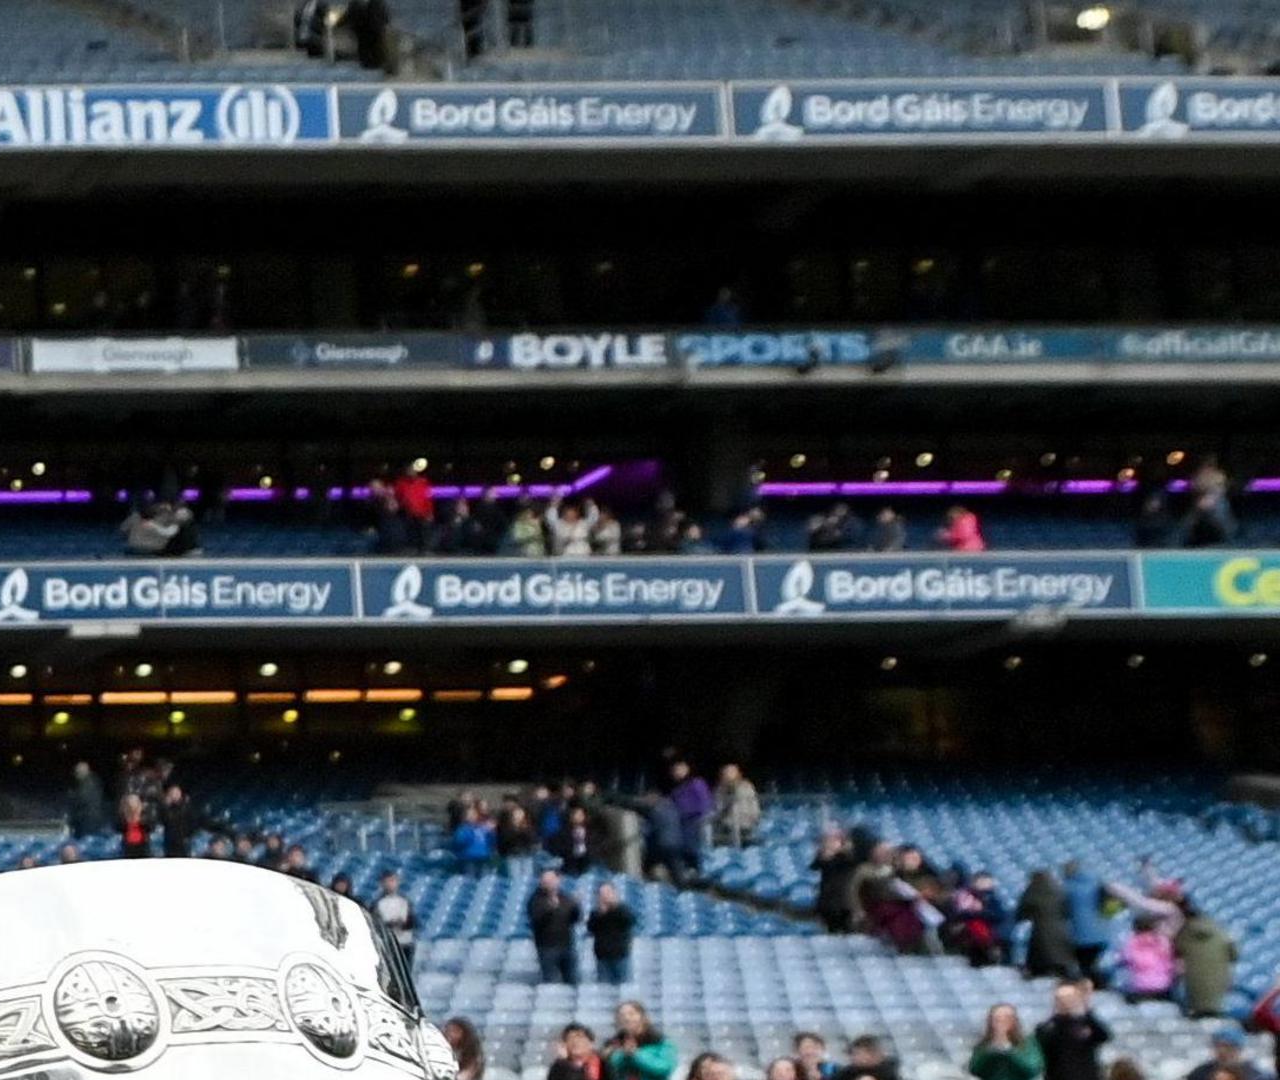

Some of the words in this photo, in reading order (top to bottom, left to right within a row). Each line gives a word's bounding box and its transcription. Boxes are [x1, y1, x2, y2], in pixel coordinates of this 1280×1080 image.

[411, 98, 494, 131] Bord
[500, 97, 574, 131] Gáis
[579, 98, 697, 134] Energy
[803, 94, 890, 127] Bord
[973, 94, 1089, 130] Energy
[509, 332, 667, 367] BOYLE
[676, 332, 870, 364] SPORTS
[44, 576, 128, 609] Bord
[134, 574, 208, 608] Gáis
[212, 577, 331, 613] Energy
[437, 573, 521, 606] Bord
[526, 571, 600, 606] Gáis
[606, 573, 724, 609] Energy
[826, 569, 913, 602] Bord
[918, 567, 992, 601] Gáis
[997, 568, 1114, 605] Energy
